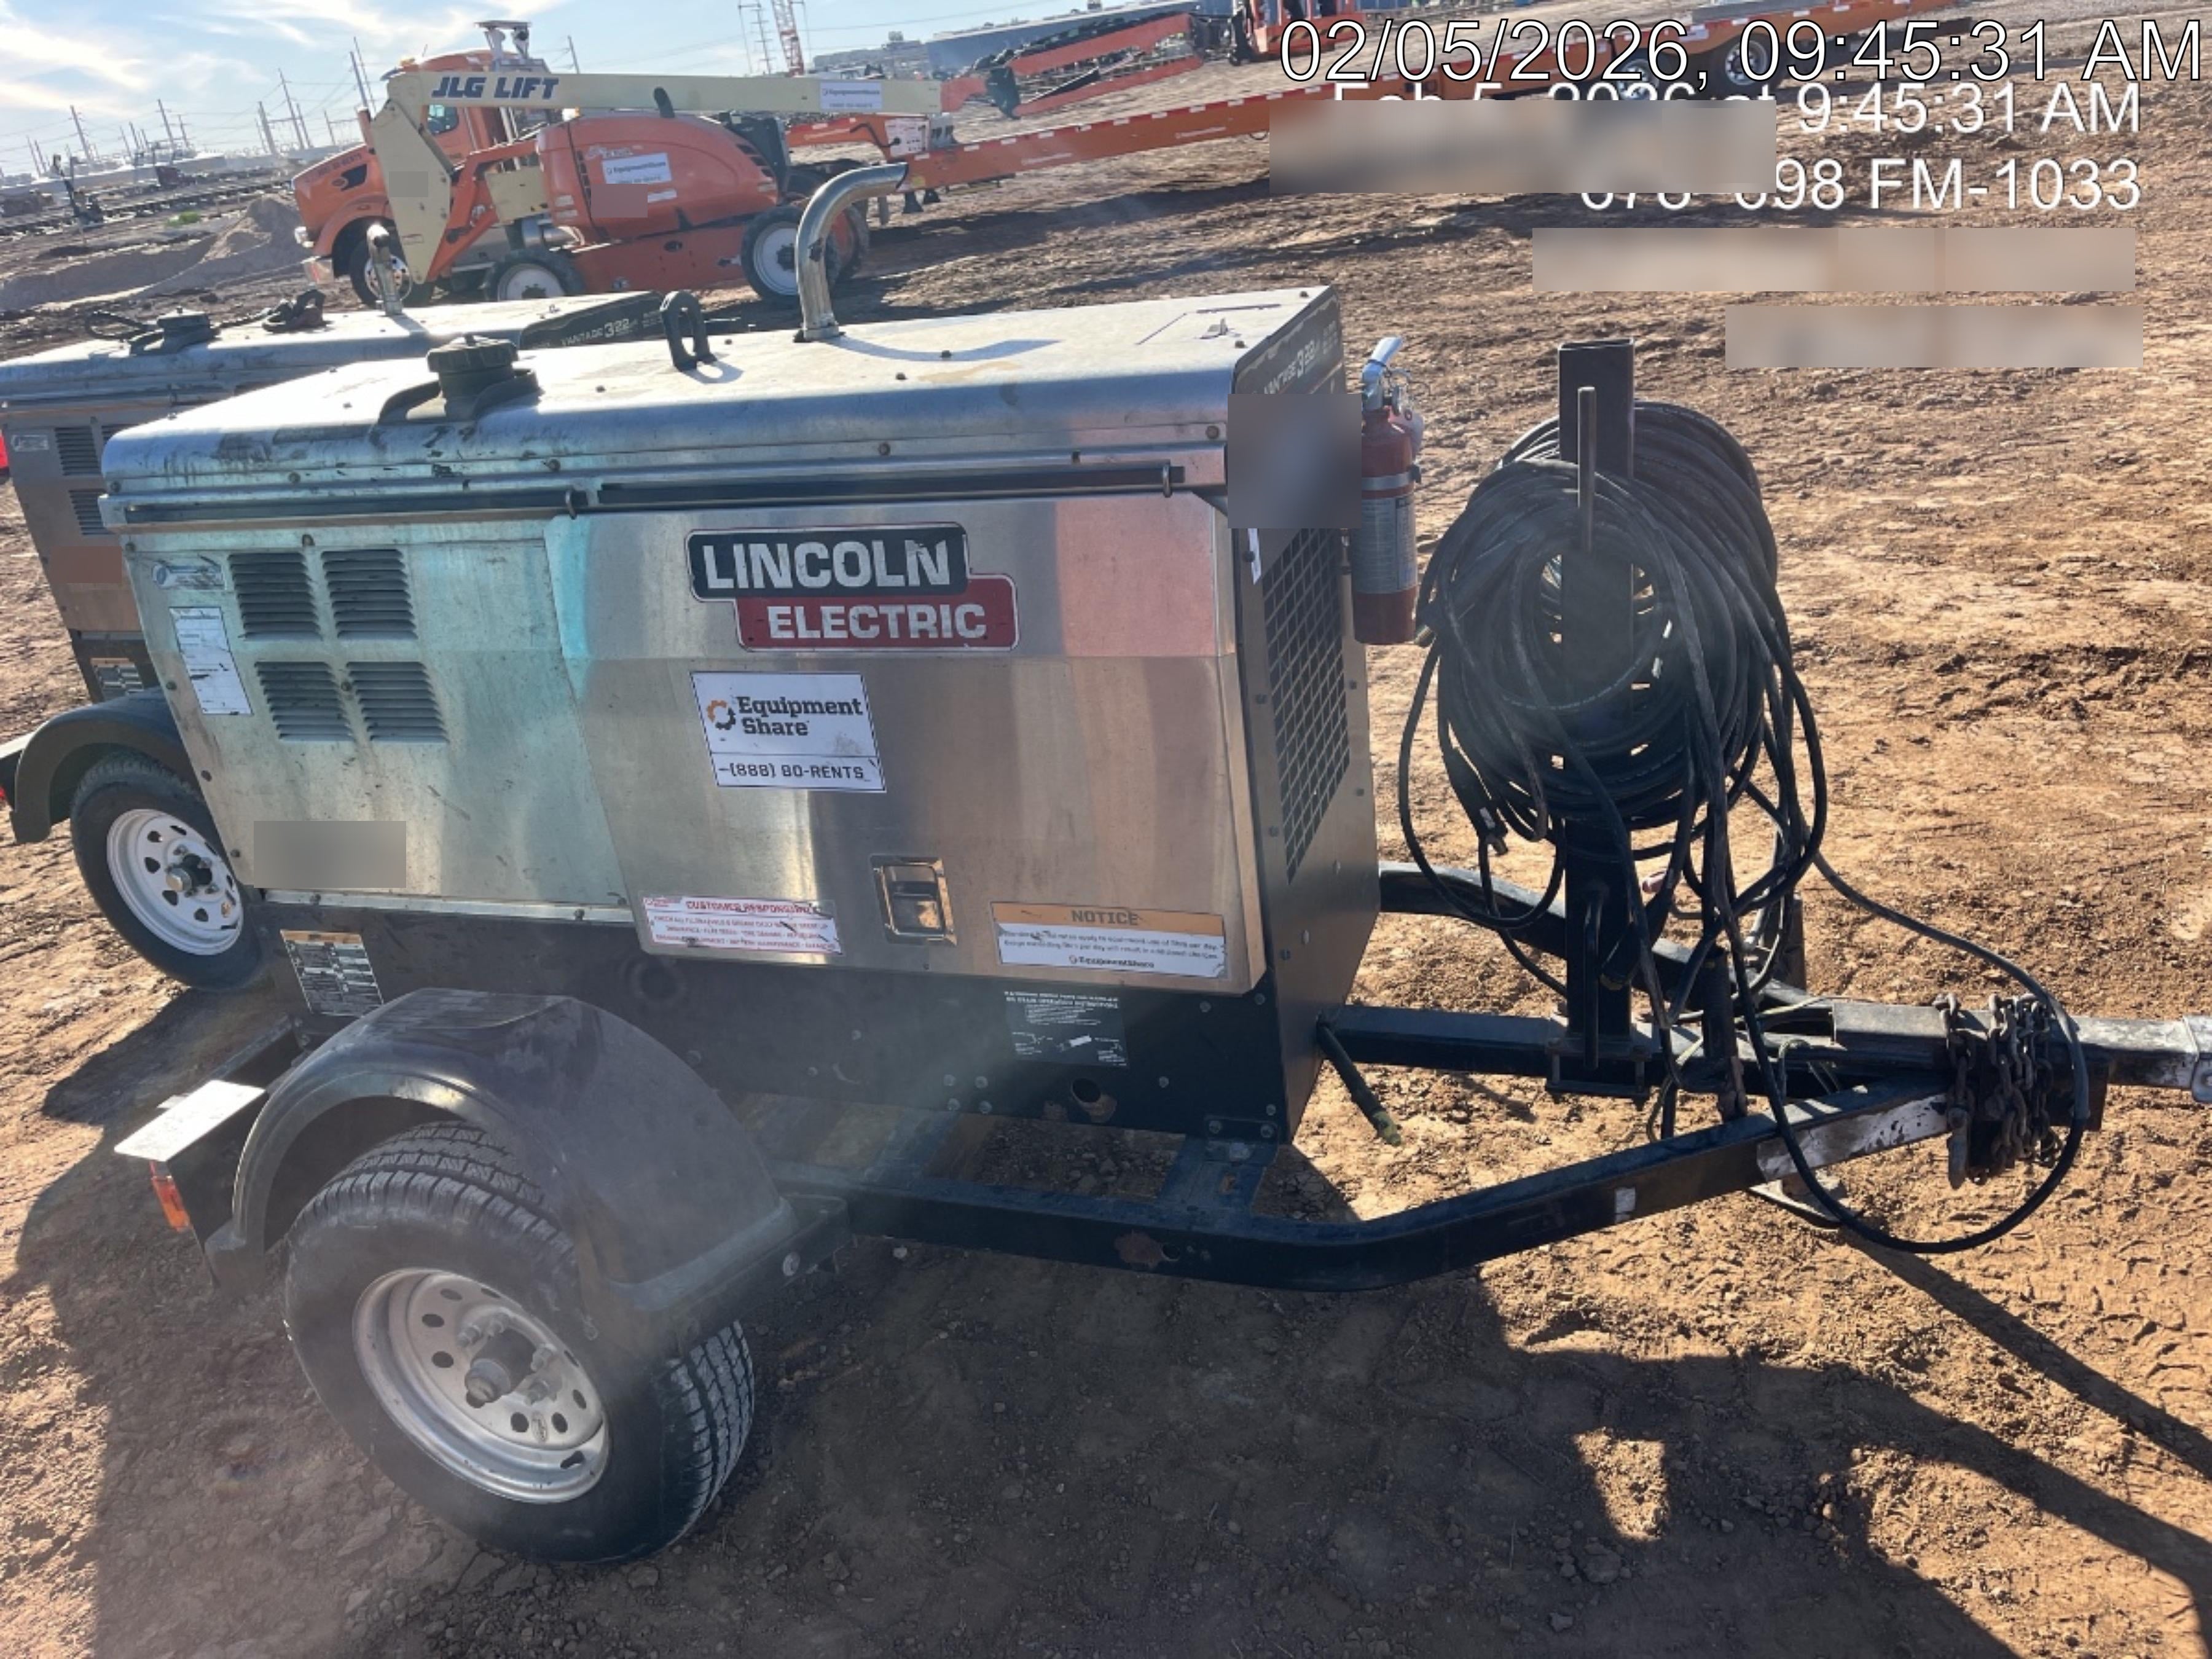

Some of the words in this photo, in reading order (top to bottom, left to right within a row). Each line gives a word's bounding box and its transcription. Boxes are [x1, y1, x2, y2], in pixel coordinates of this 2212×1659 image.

[431, 77, 487, 98] JLG
[494, 77, 559, 99] LIFT
[702, 539, 951, 589] LINCOLN
[767, 603, 987, 639] ELECTRIC
[737, 696, 863, 717] Equipment
[742, 718, 809, 736] Share
[730, 763, 775, 778] (888)
[1071, 910, 1139, 925] NOTICE
